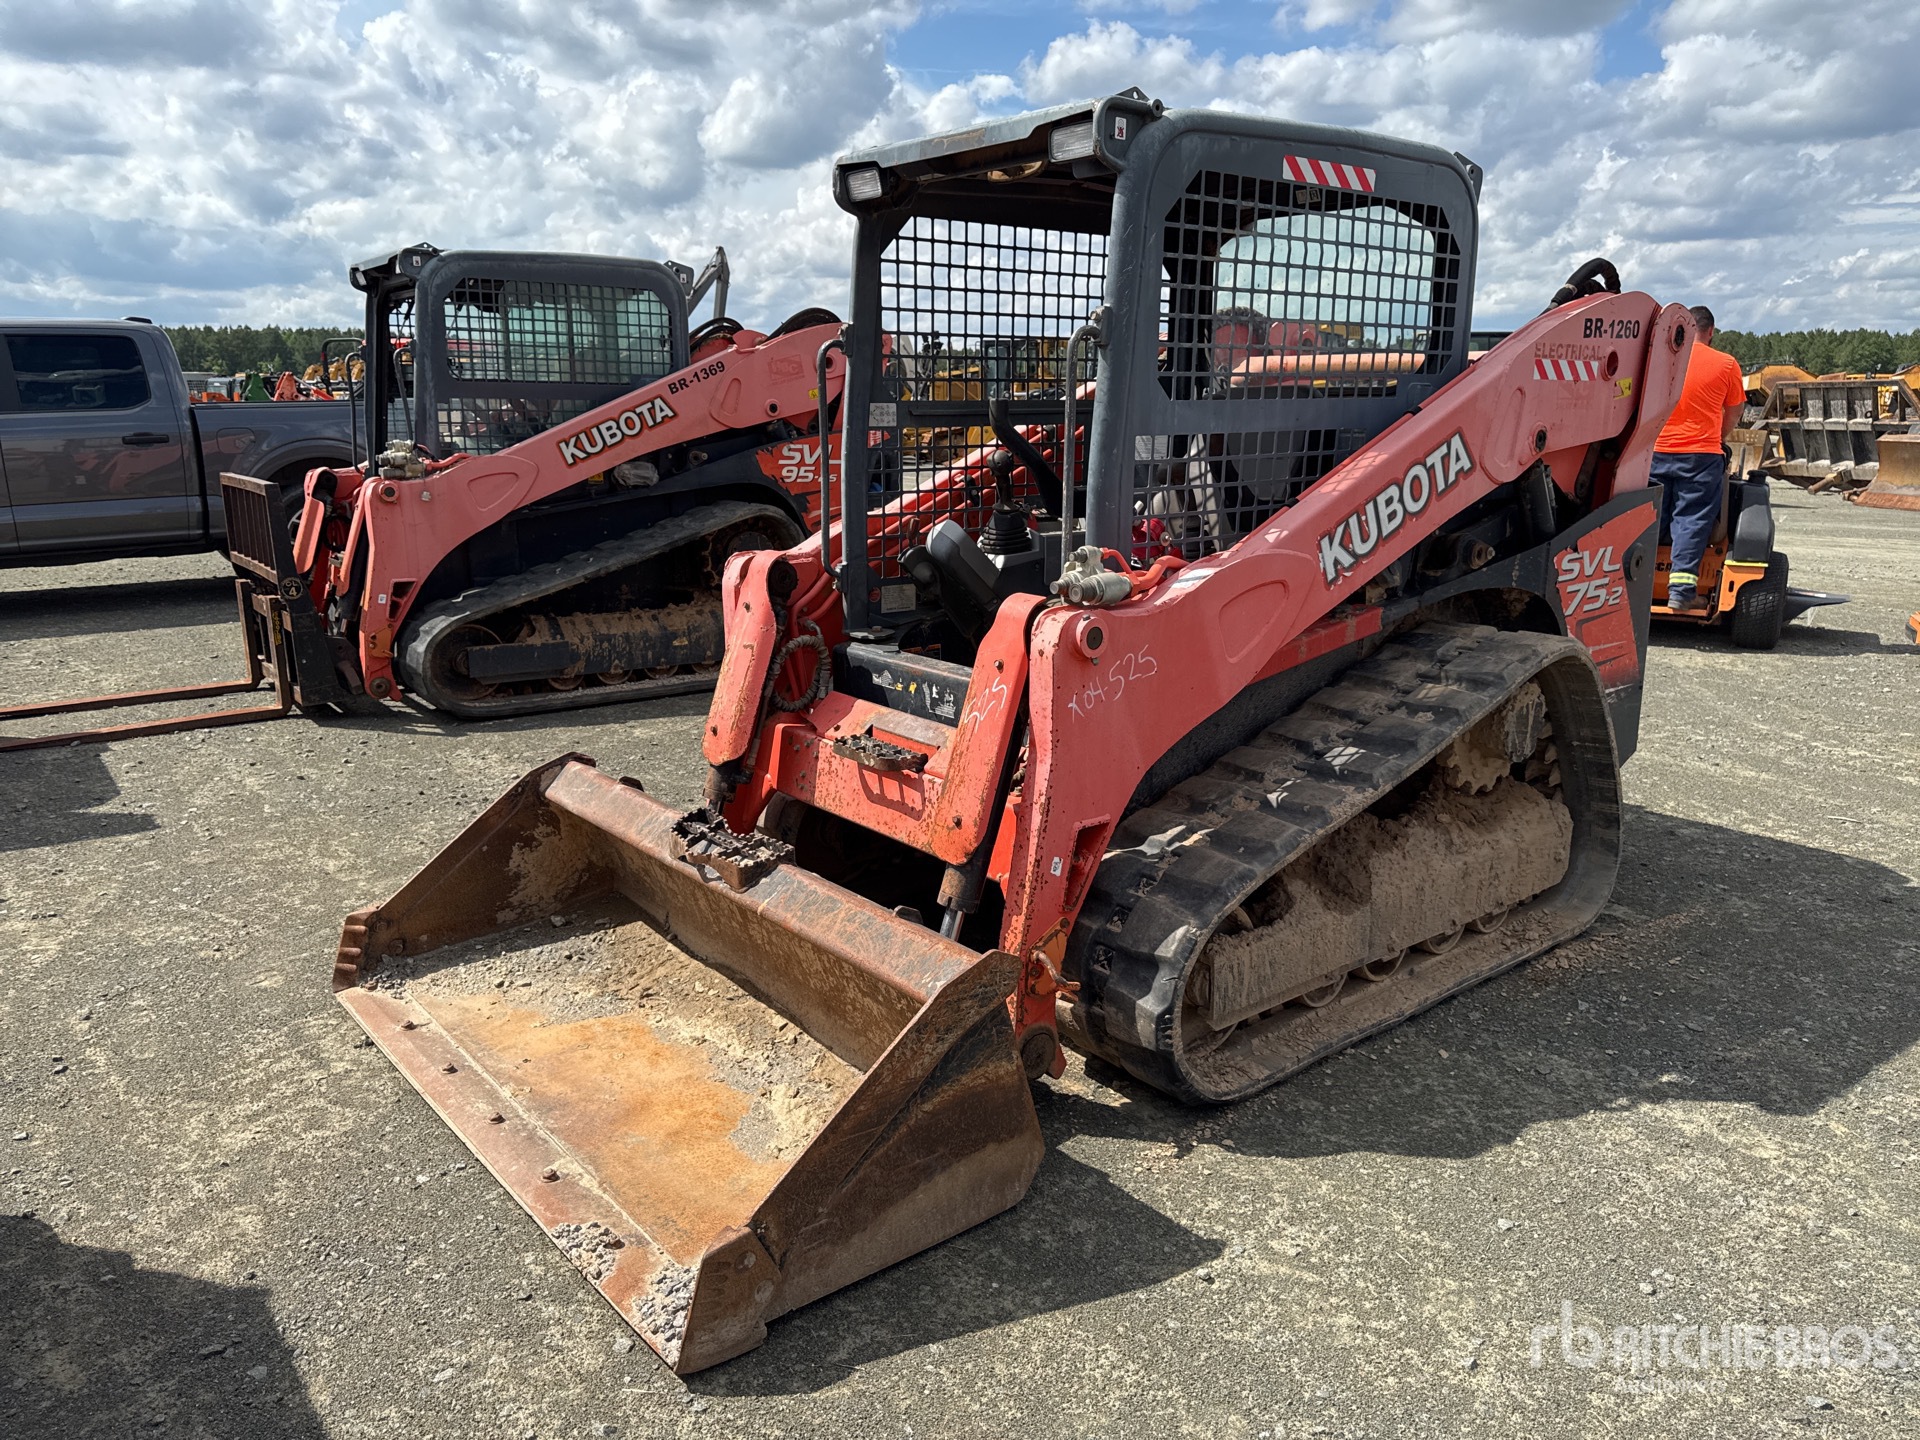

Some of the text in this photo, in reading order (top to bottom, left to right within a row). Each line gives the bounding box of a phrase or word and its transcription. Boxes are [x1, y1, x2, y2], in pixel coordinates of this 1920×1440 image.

[1583, 318, 1640, 339] BR-1260
[1534, 342, 1602, 360] ELECTRICAL
[668, 361, 725, 395] BR-1369
[559, 397, 676, 465] KUBOTA
[1319, 432, 1473, 584] KUBOTA
[1557, 545, 1621, 582] SVL
[288, 586, 297, 597] 4
[1564, 577, 1623, 616] 75-2
[964, 676, 1007, 734] 525
